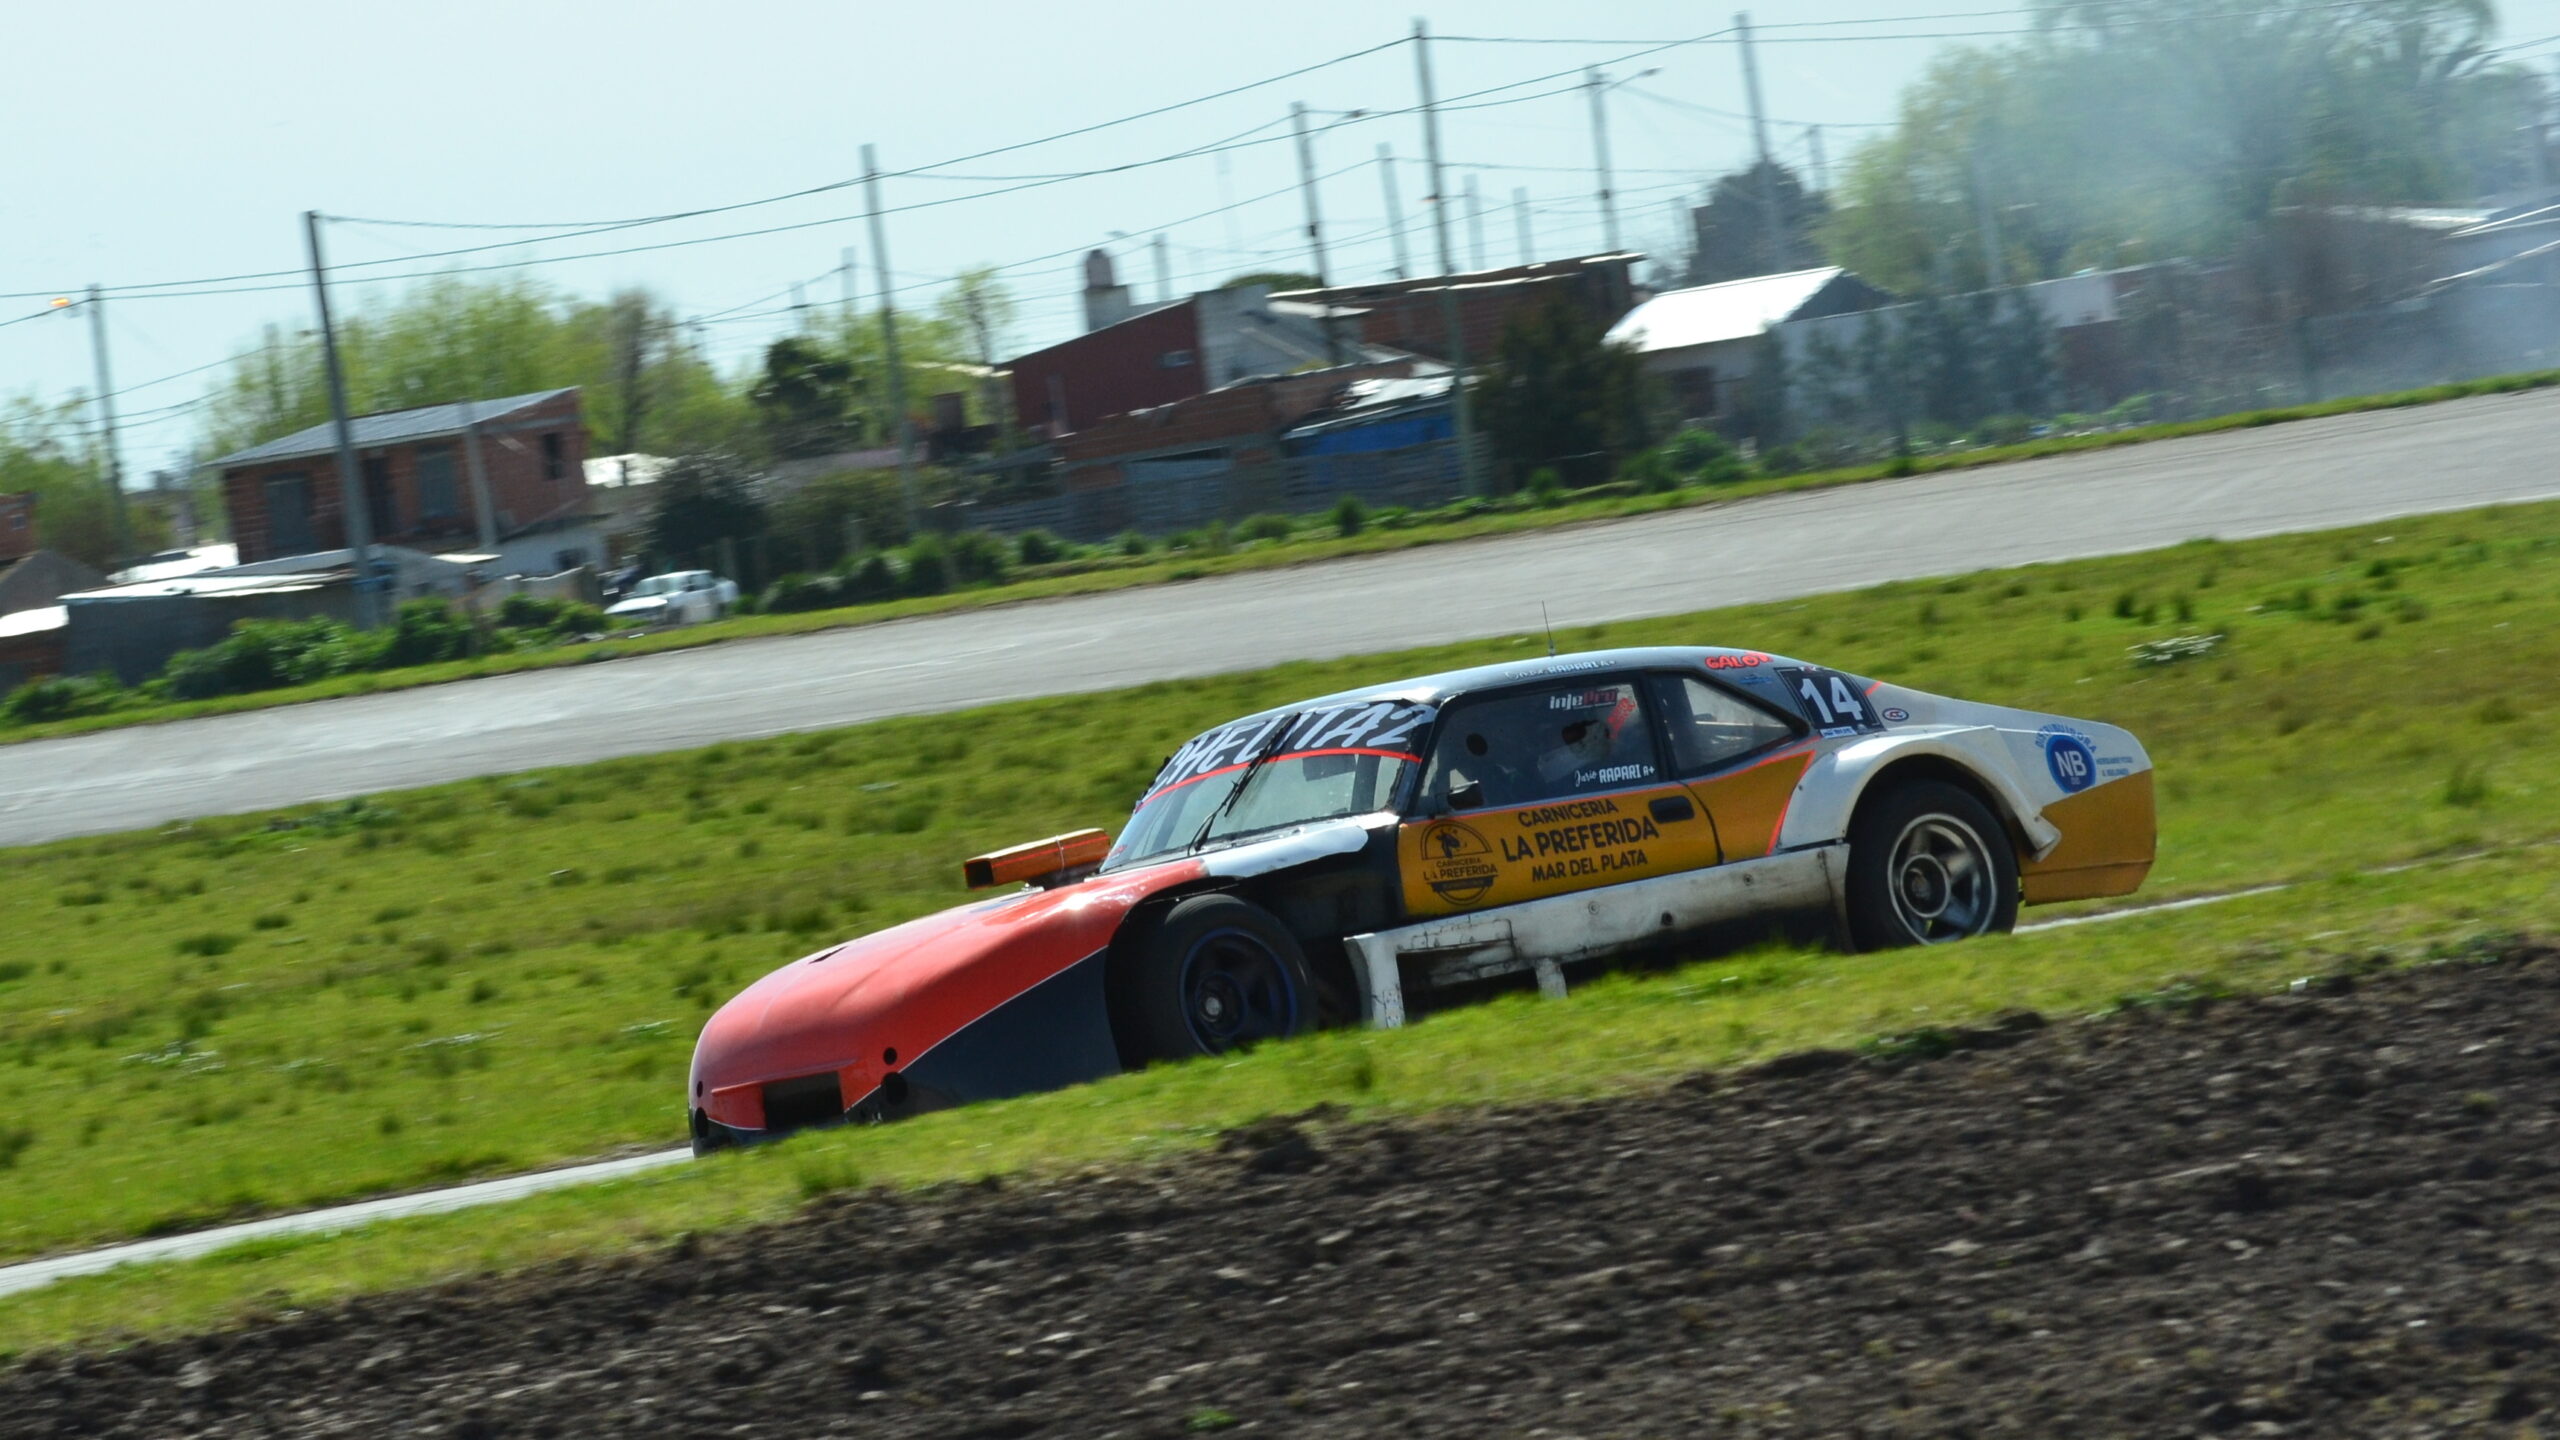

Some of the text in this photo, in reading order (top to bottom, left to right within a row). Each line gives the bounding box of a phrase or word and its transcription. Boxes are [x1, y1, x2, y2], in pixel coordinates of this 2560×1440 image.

[1801, 677, 1863, 723] 14
[1599, 764, 1642, 784] RAPARI
[2054, 750, 2087, 778] NB
[1518, 799, 1620, 828] CARNICERIA
[1500, 816, 1660, 862] LA PREFERIDA
[1439, 863, 1499, 880] PREFERIDA
[1532, 849, 1649, 883] MAR DEL PLATA
